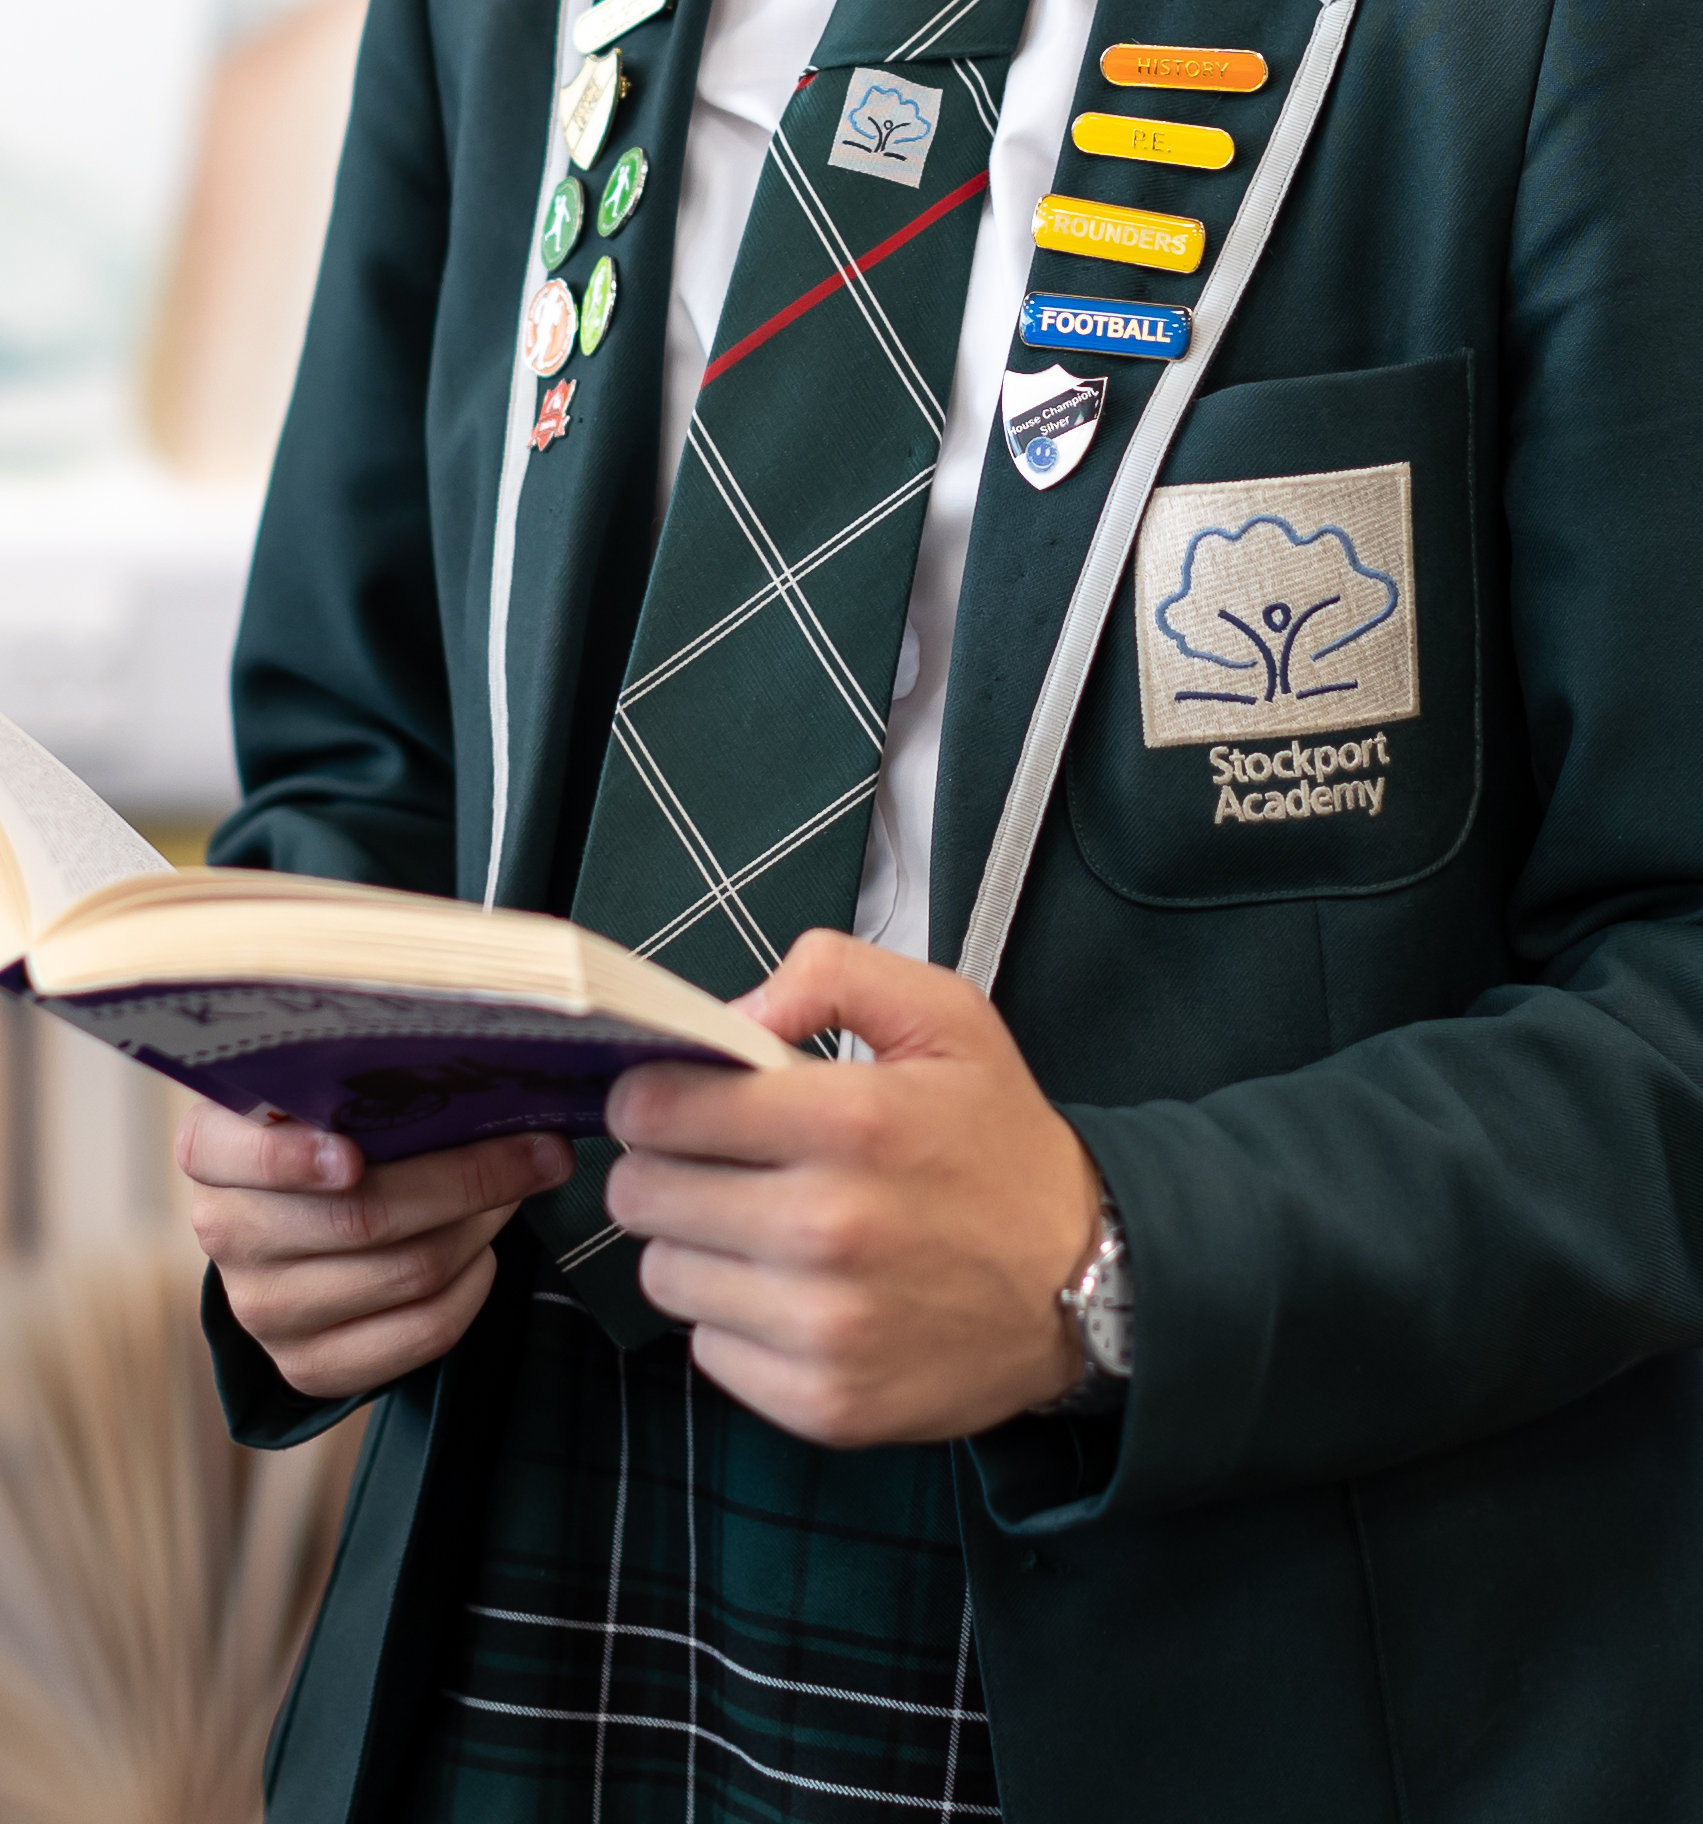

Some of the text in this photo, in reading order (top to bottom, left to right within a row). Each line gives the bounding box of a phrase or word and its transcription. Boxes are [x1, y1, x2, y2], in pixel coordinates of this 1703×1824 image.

[1137, 57, 1230, 79] HISTORY
[1131, 128, 1172, 153] P.E.
[1052, 212, 1189, 256] ROUNDERS
[1040, 309, 1172, 344] FOOTBALL
[1006, 388, 1100, 436] House Champion
[1039, 415, 1070, 436] Silver
[1209, 730, 1391, 785] Stockport
[1213, 776, 1386, 825] Academy
